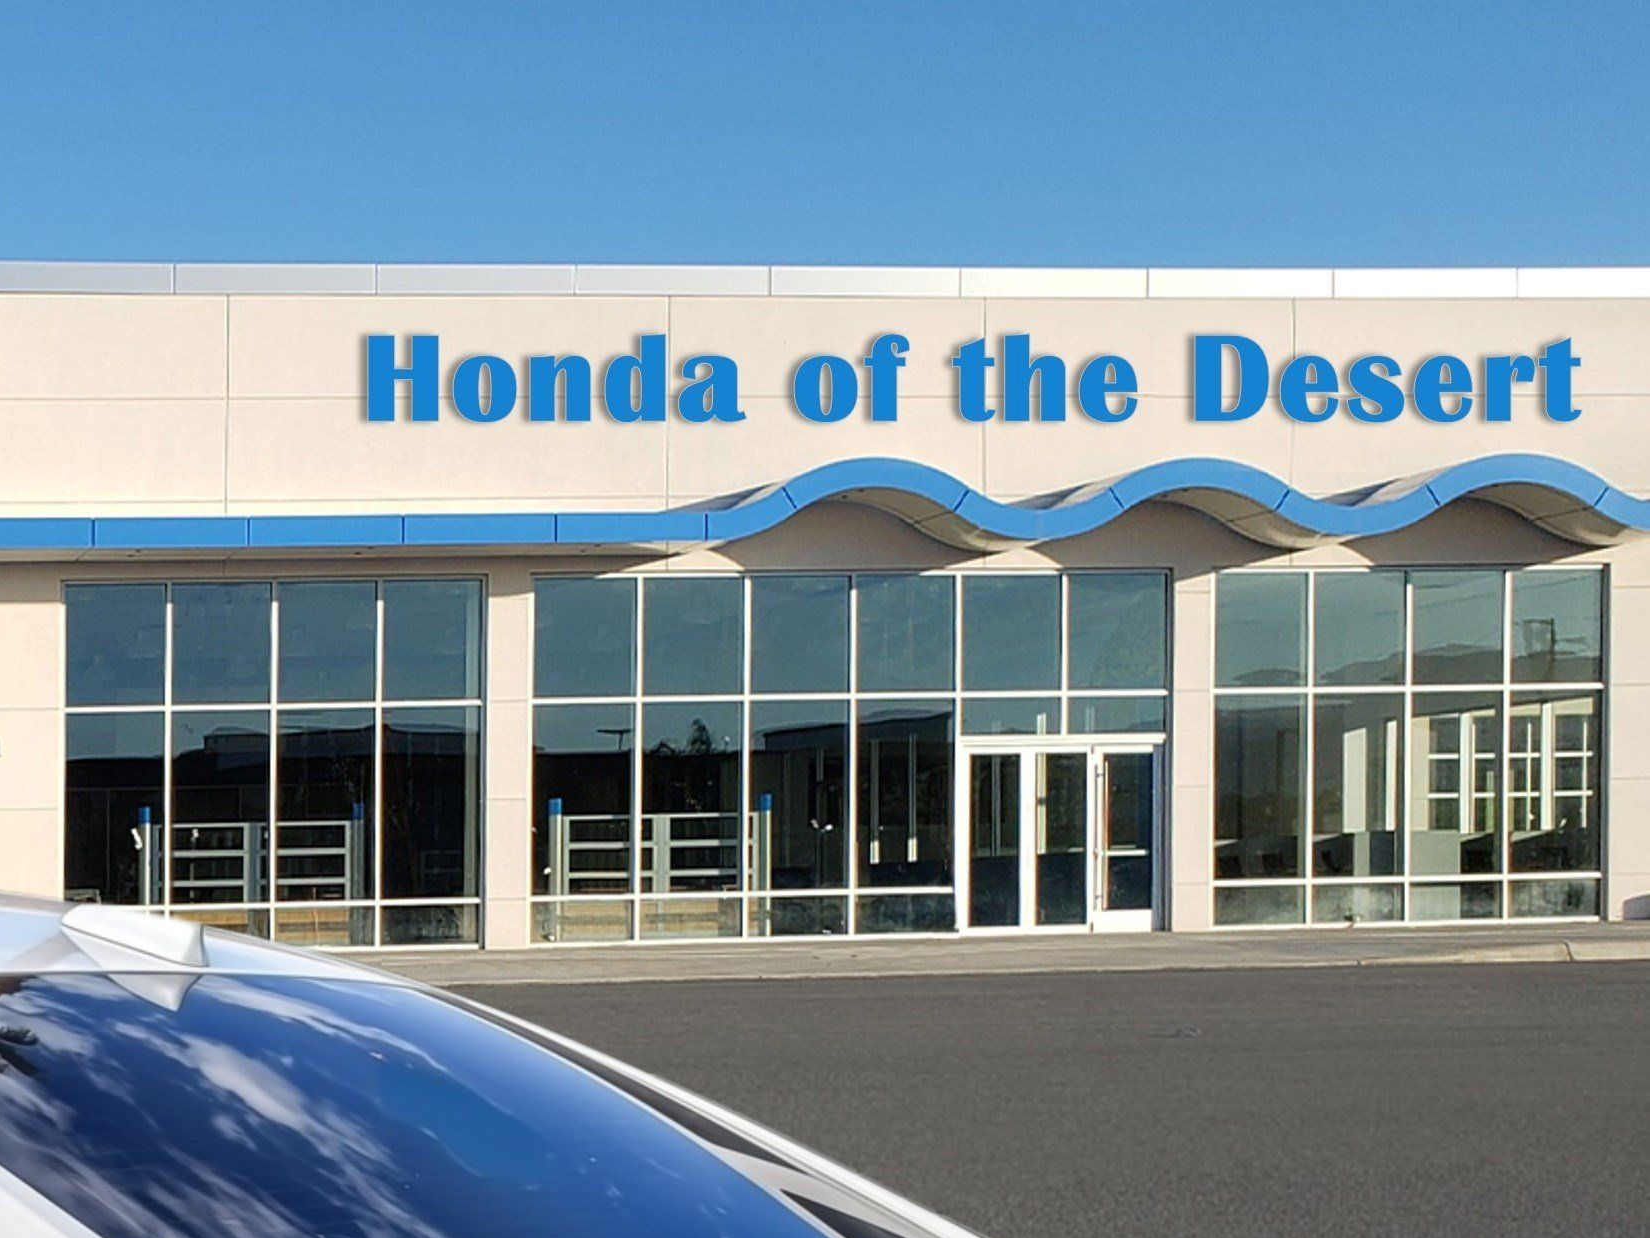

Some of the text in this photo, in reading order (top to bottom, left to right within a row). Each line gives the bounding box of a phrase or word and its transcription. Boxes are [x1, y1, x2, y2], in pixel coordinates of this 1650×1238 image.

[367, 333, 1583, 424] Honda of the Desert
